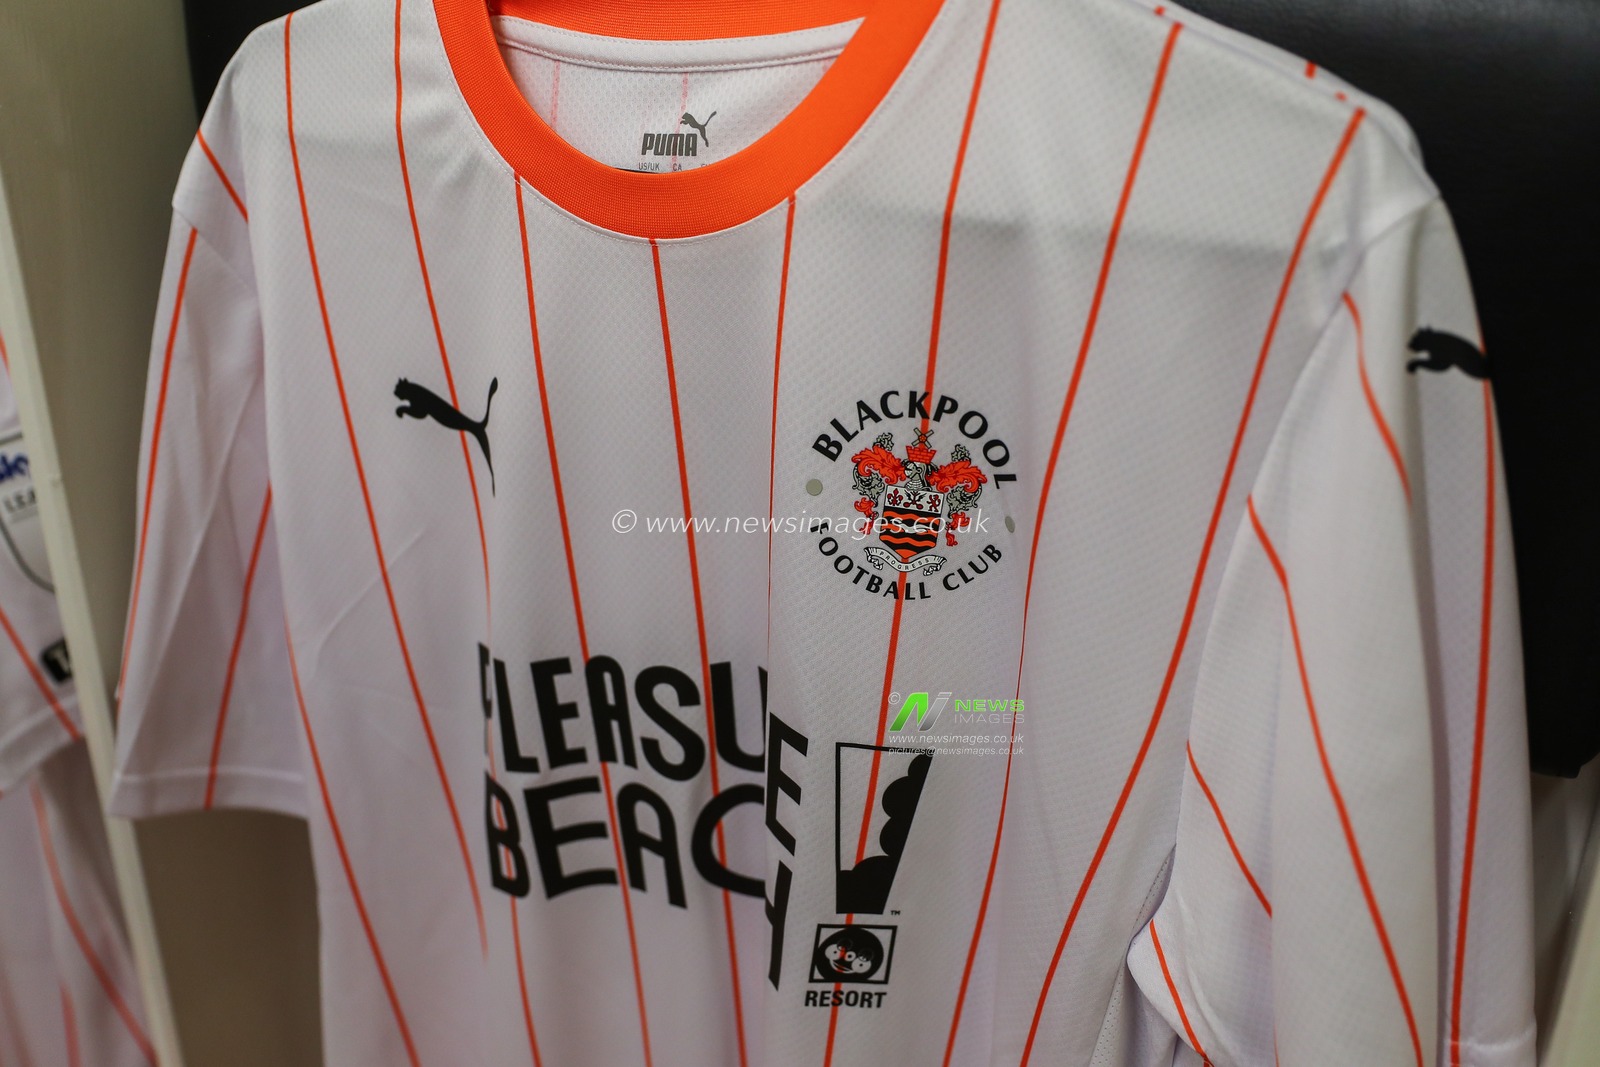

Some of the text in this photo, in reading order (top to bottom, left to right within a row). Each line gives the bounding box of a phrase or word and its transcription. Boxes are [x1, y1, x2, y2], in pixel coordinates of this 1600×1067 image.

[641, 133, 698, 156] PUMA
[638, 162, 682, 172] US/UK CA
[812, 390, 1017, 489] BLACKPOOL
[810, 522, 1003, 601] FOOTBALL CLUB
[879, 551, 930, 571] PROGRESS
[804, 990, 887, 1008] RESORT
